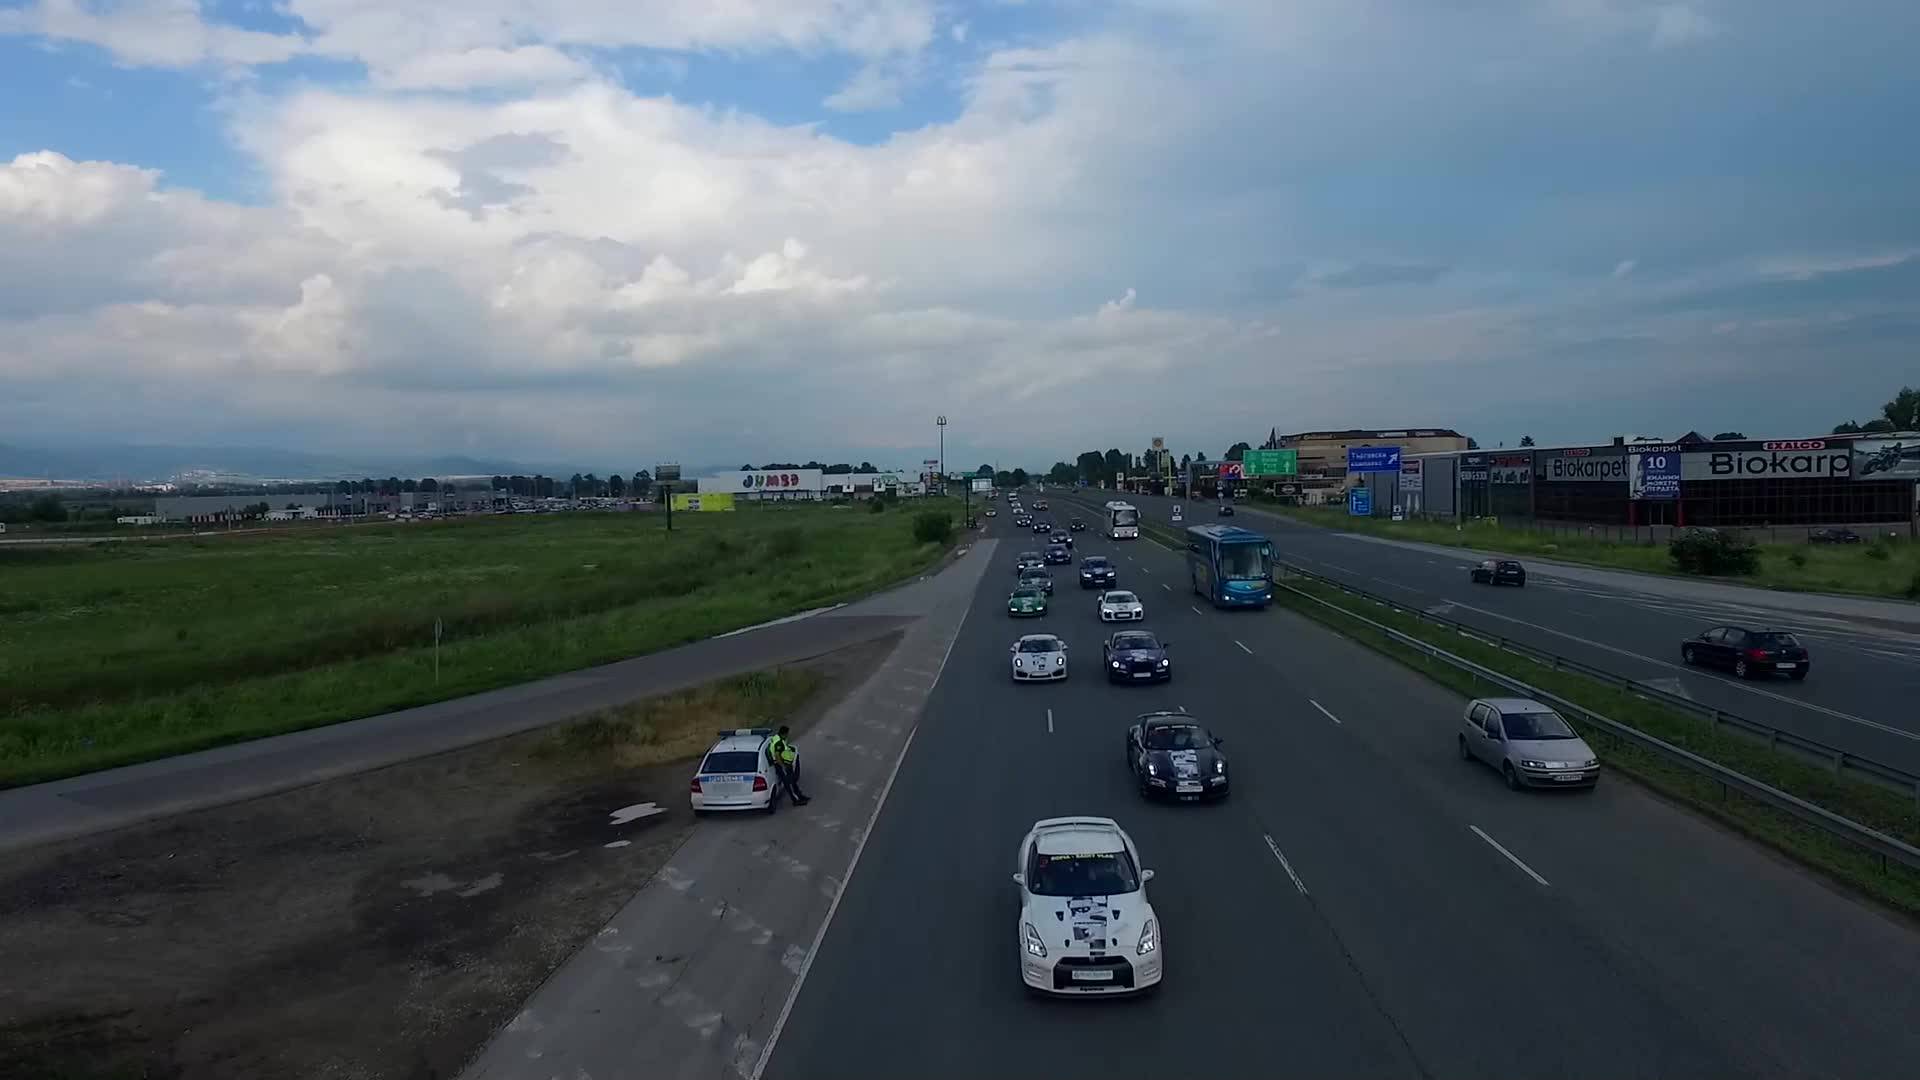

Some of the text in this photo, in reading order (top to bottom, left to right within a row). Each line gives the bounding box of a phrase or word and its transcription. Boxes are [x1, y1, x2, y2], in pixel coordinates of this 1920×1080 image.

[1628, 445, 1681, 453] Biokarpet
[1767, 441, 1821, 449] EXALCO
[1553, 456, 1627, 480] Biokarpet
[1647, 456, 1666, 469] 10
[743, 473, 799, 488] JUMBO
